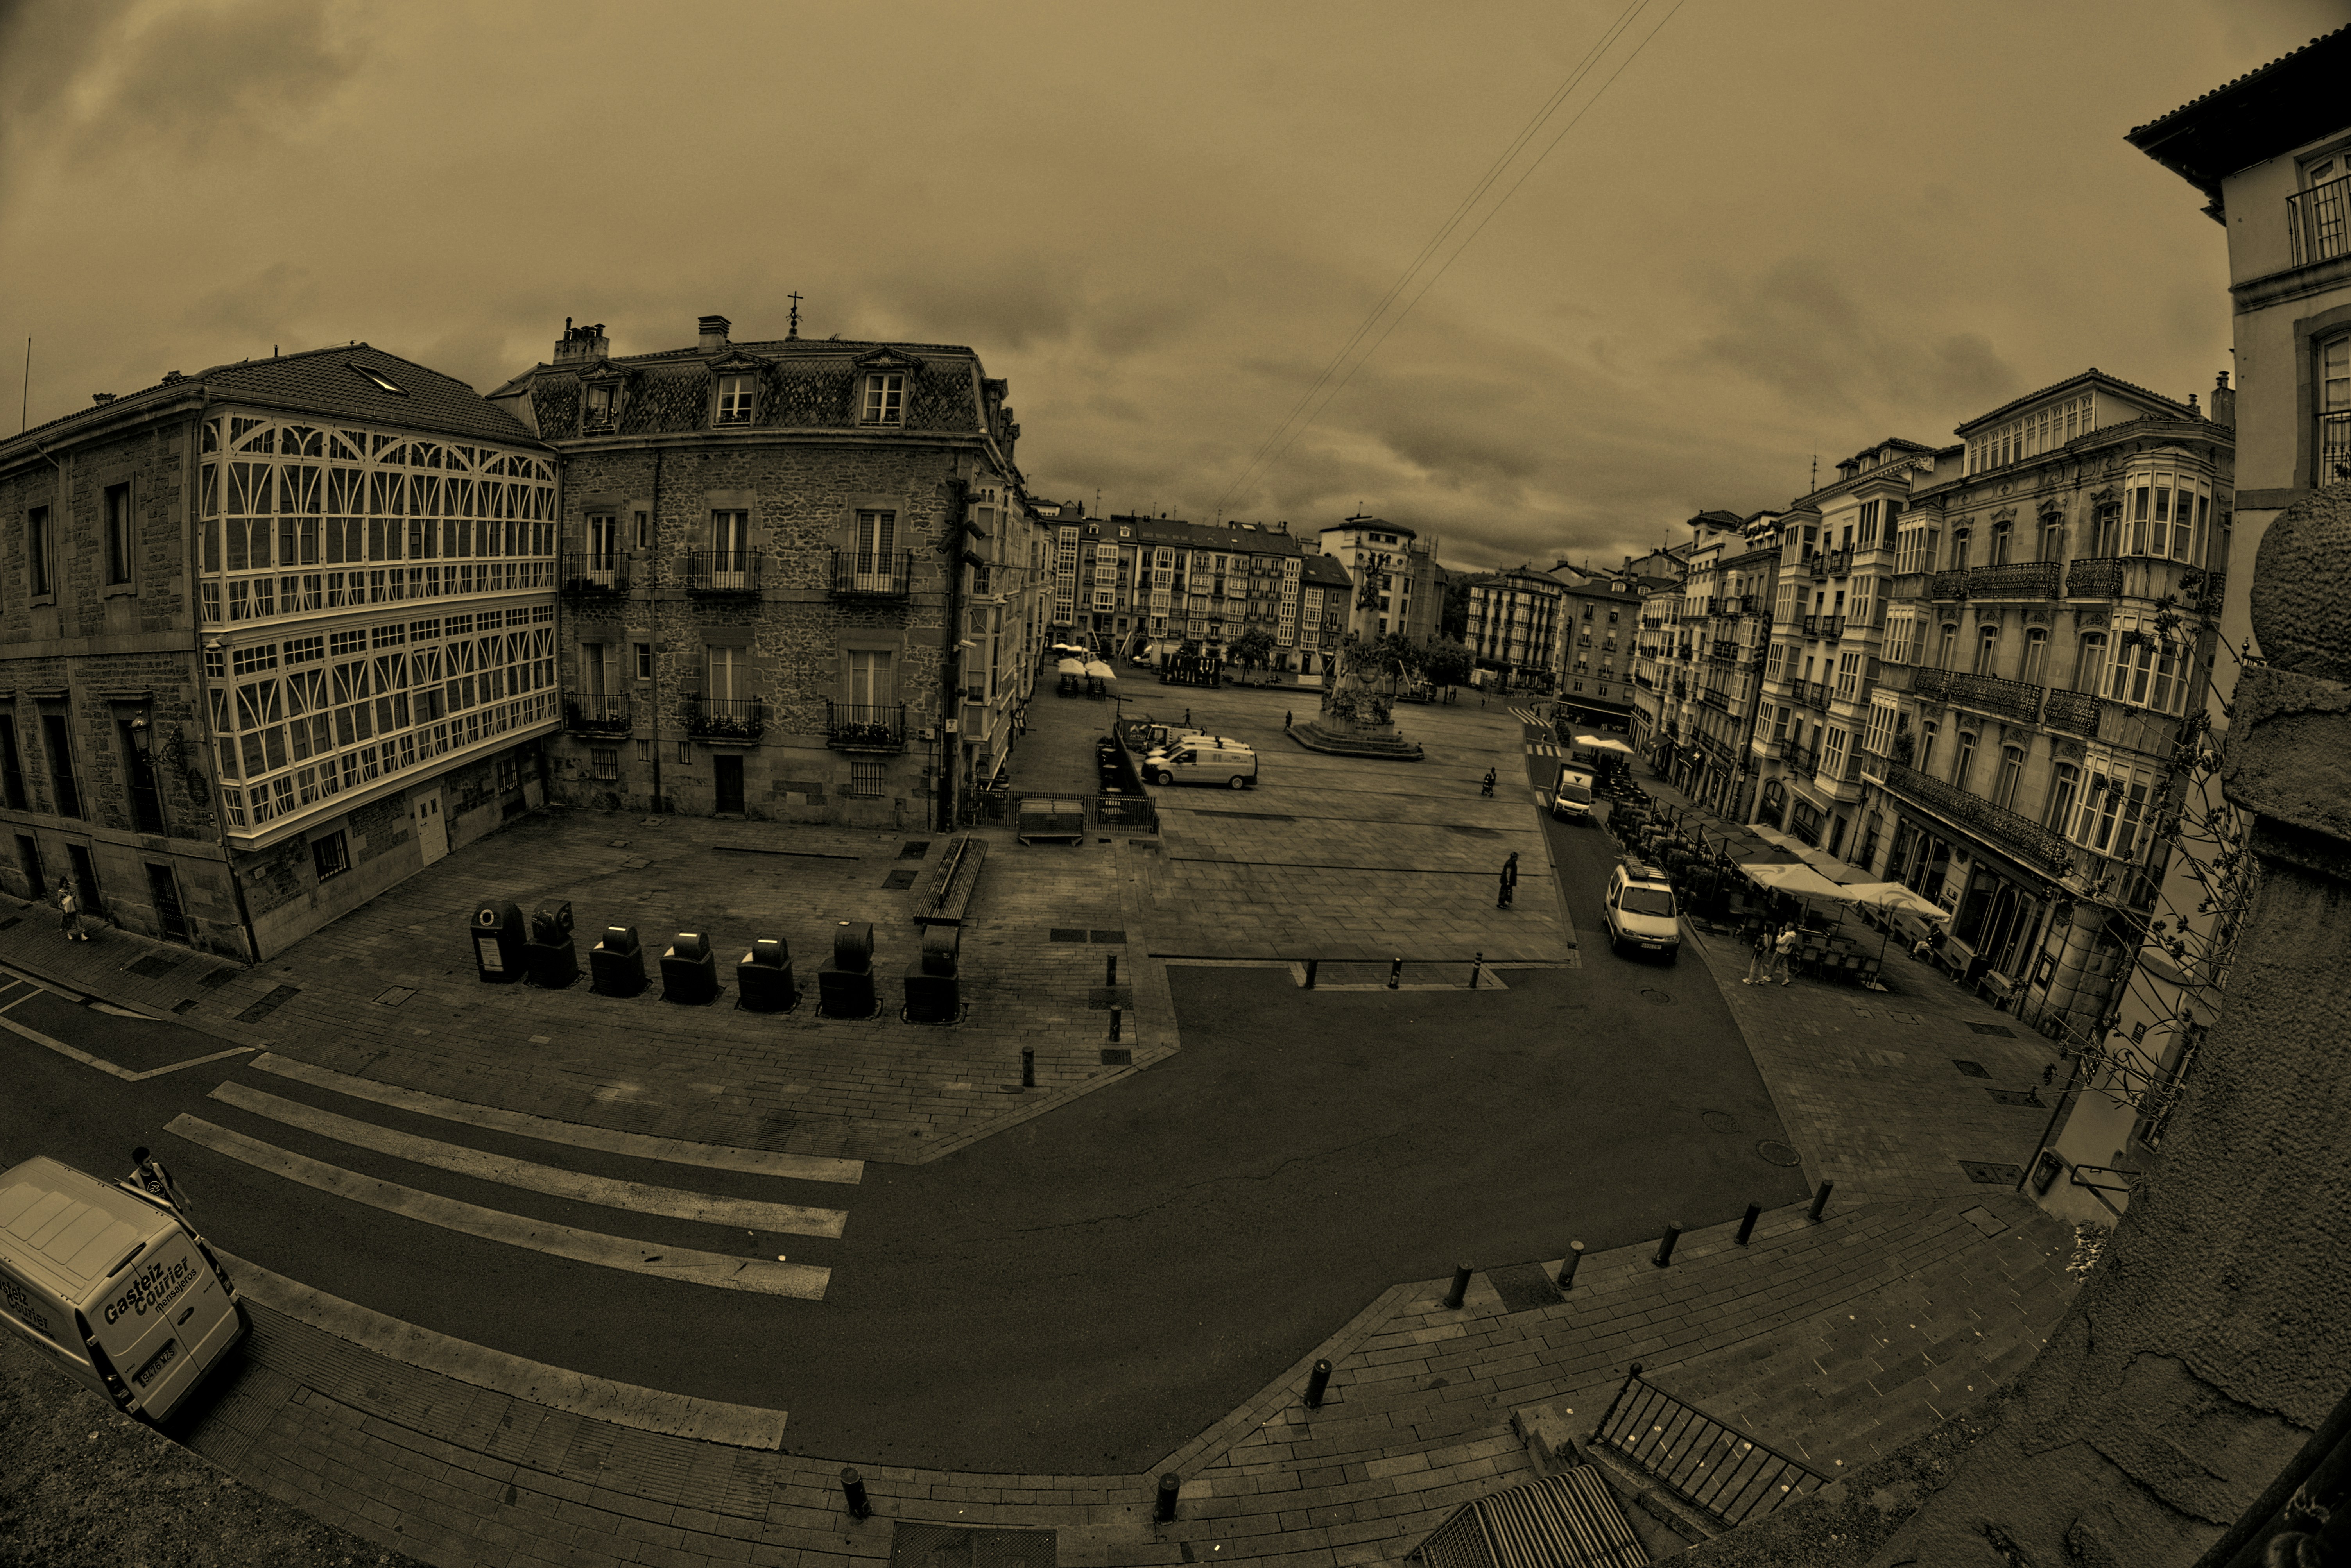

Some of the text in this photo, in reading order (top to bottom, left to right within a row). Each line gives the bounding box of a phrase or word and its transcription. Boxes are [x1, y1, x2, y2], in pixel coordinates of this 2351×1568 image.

[104, 1262, 164, 1325] Gasteiz
[134, 1256, 188, 1316] Courier
[155, 1269, 197, 1313] mensajeros
[7, 1294, 48, 1329] Courier
[143, 1348, 175, 1382] 9476 MZS
